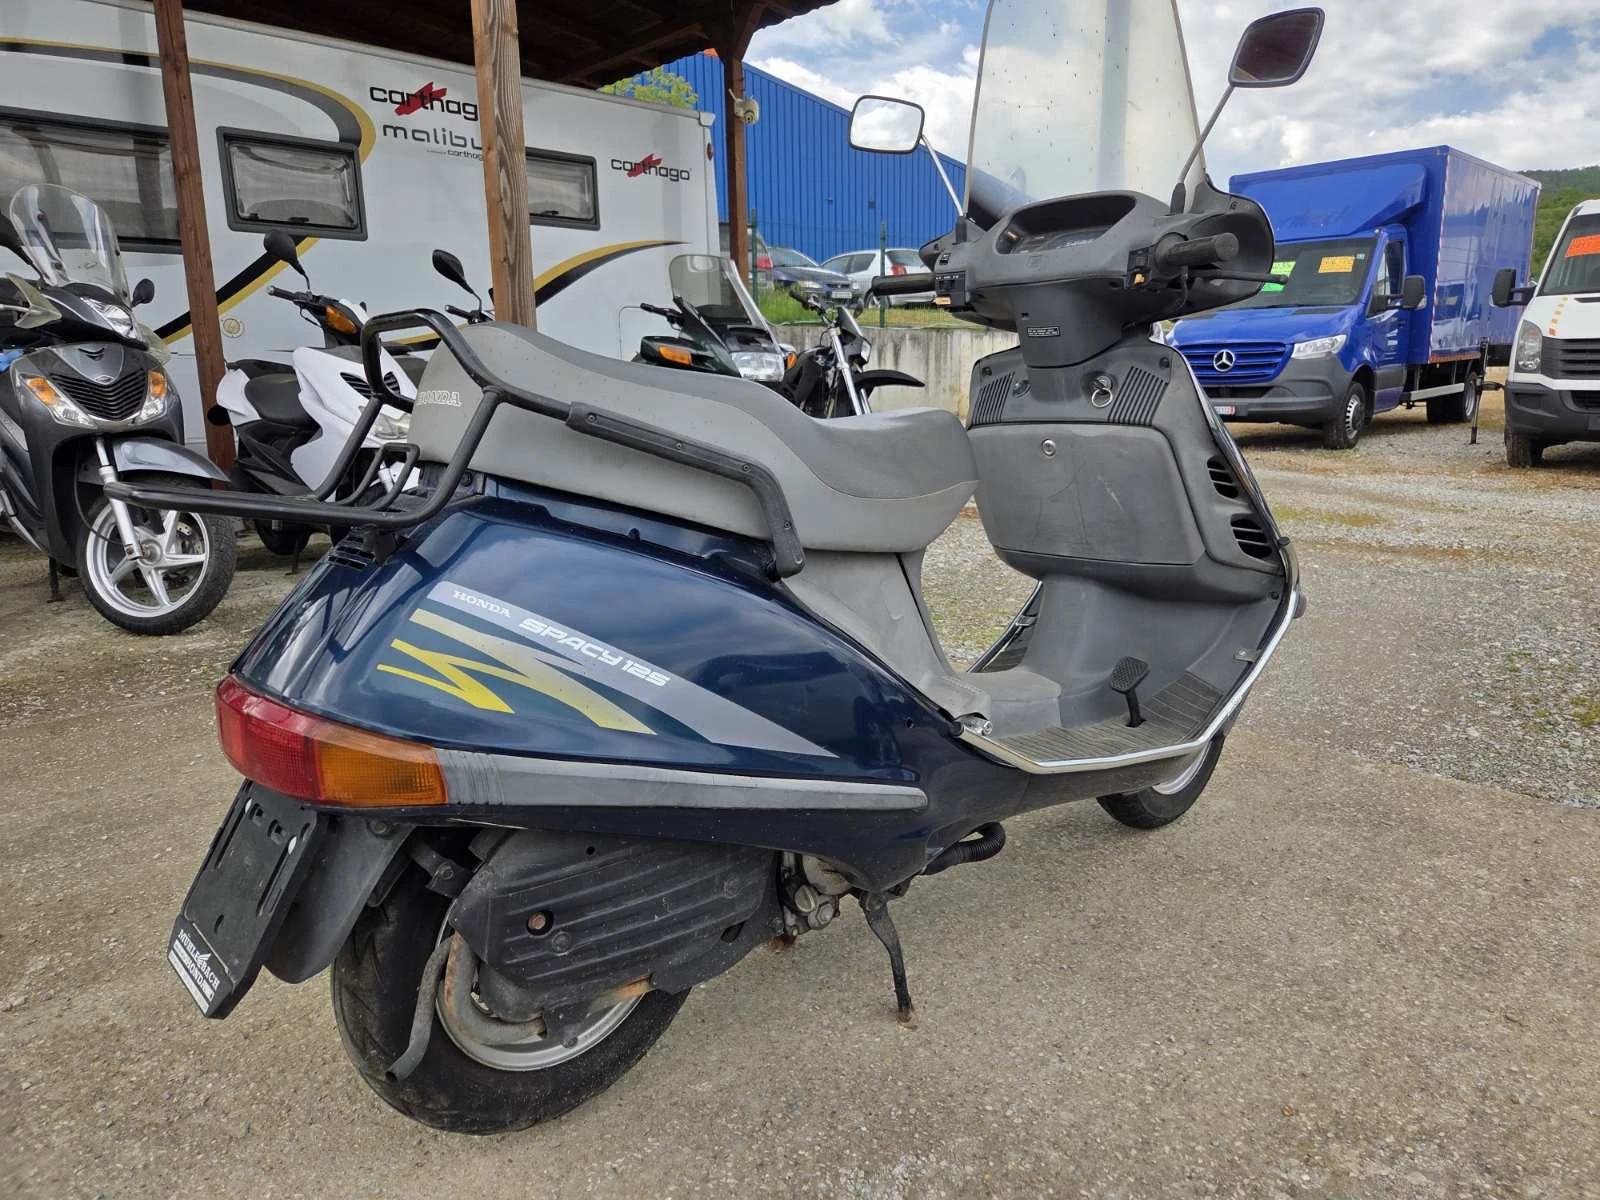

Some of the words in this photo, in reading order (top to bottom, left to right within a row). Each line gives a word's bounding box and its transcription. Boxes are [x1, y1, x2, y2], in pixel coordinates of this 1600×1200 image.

[369, 85, 479, 122] carthag
[447, 149, 484, 161] carthag
[611, 157, 690, 182] carthago
[453, 590, 512, 618] HONDA
[518, 617, 623, 666] SPACY
[620, 659, 672, 687] 125
